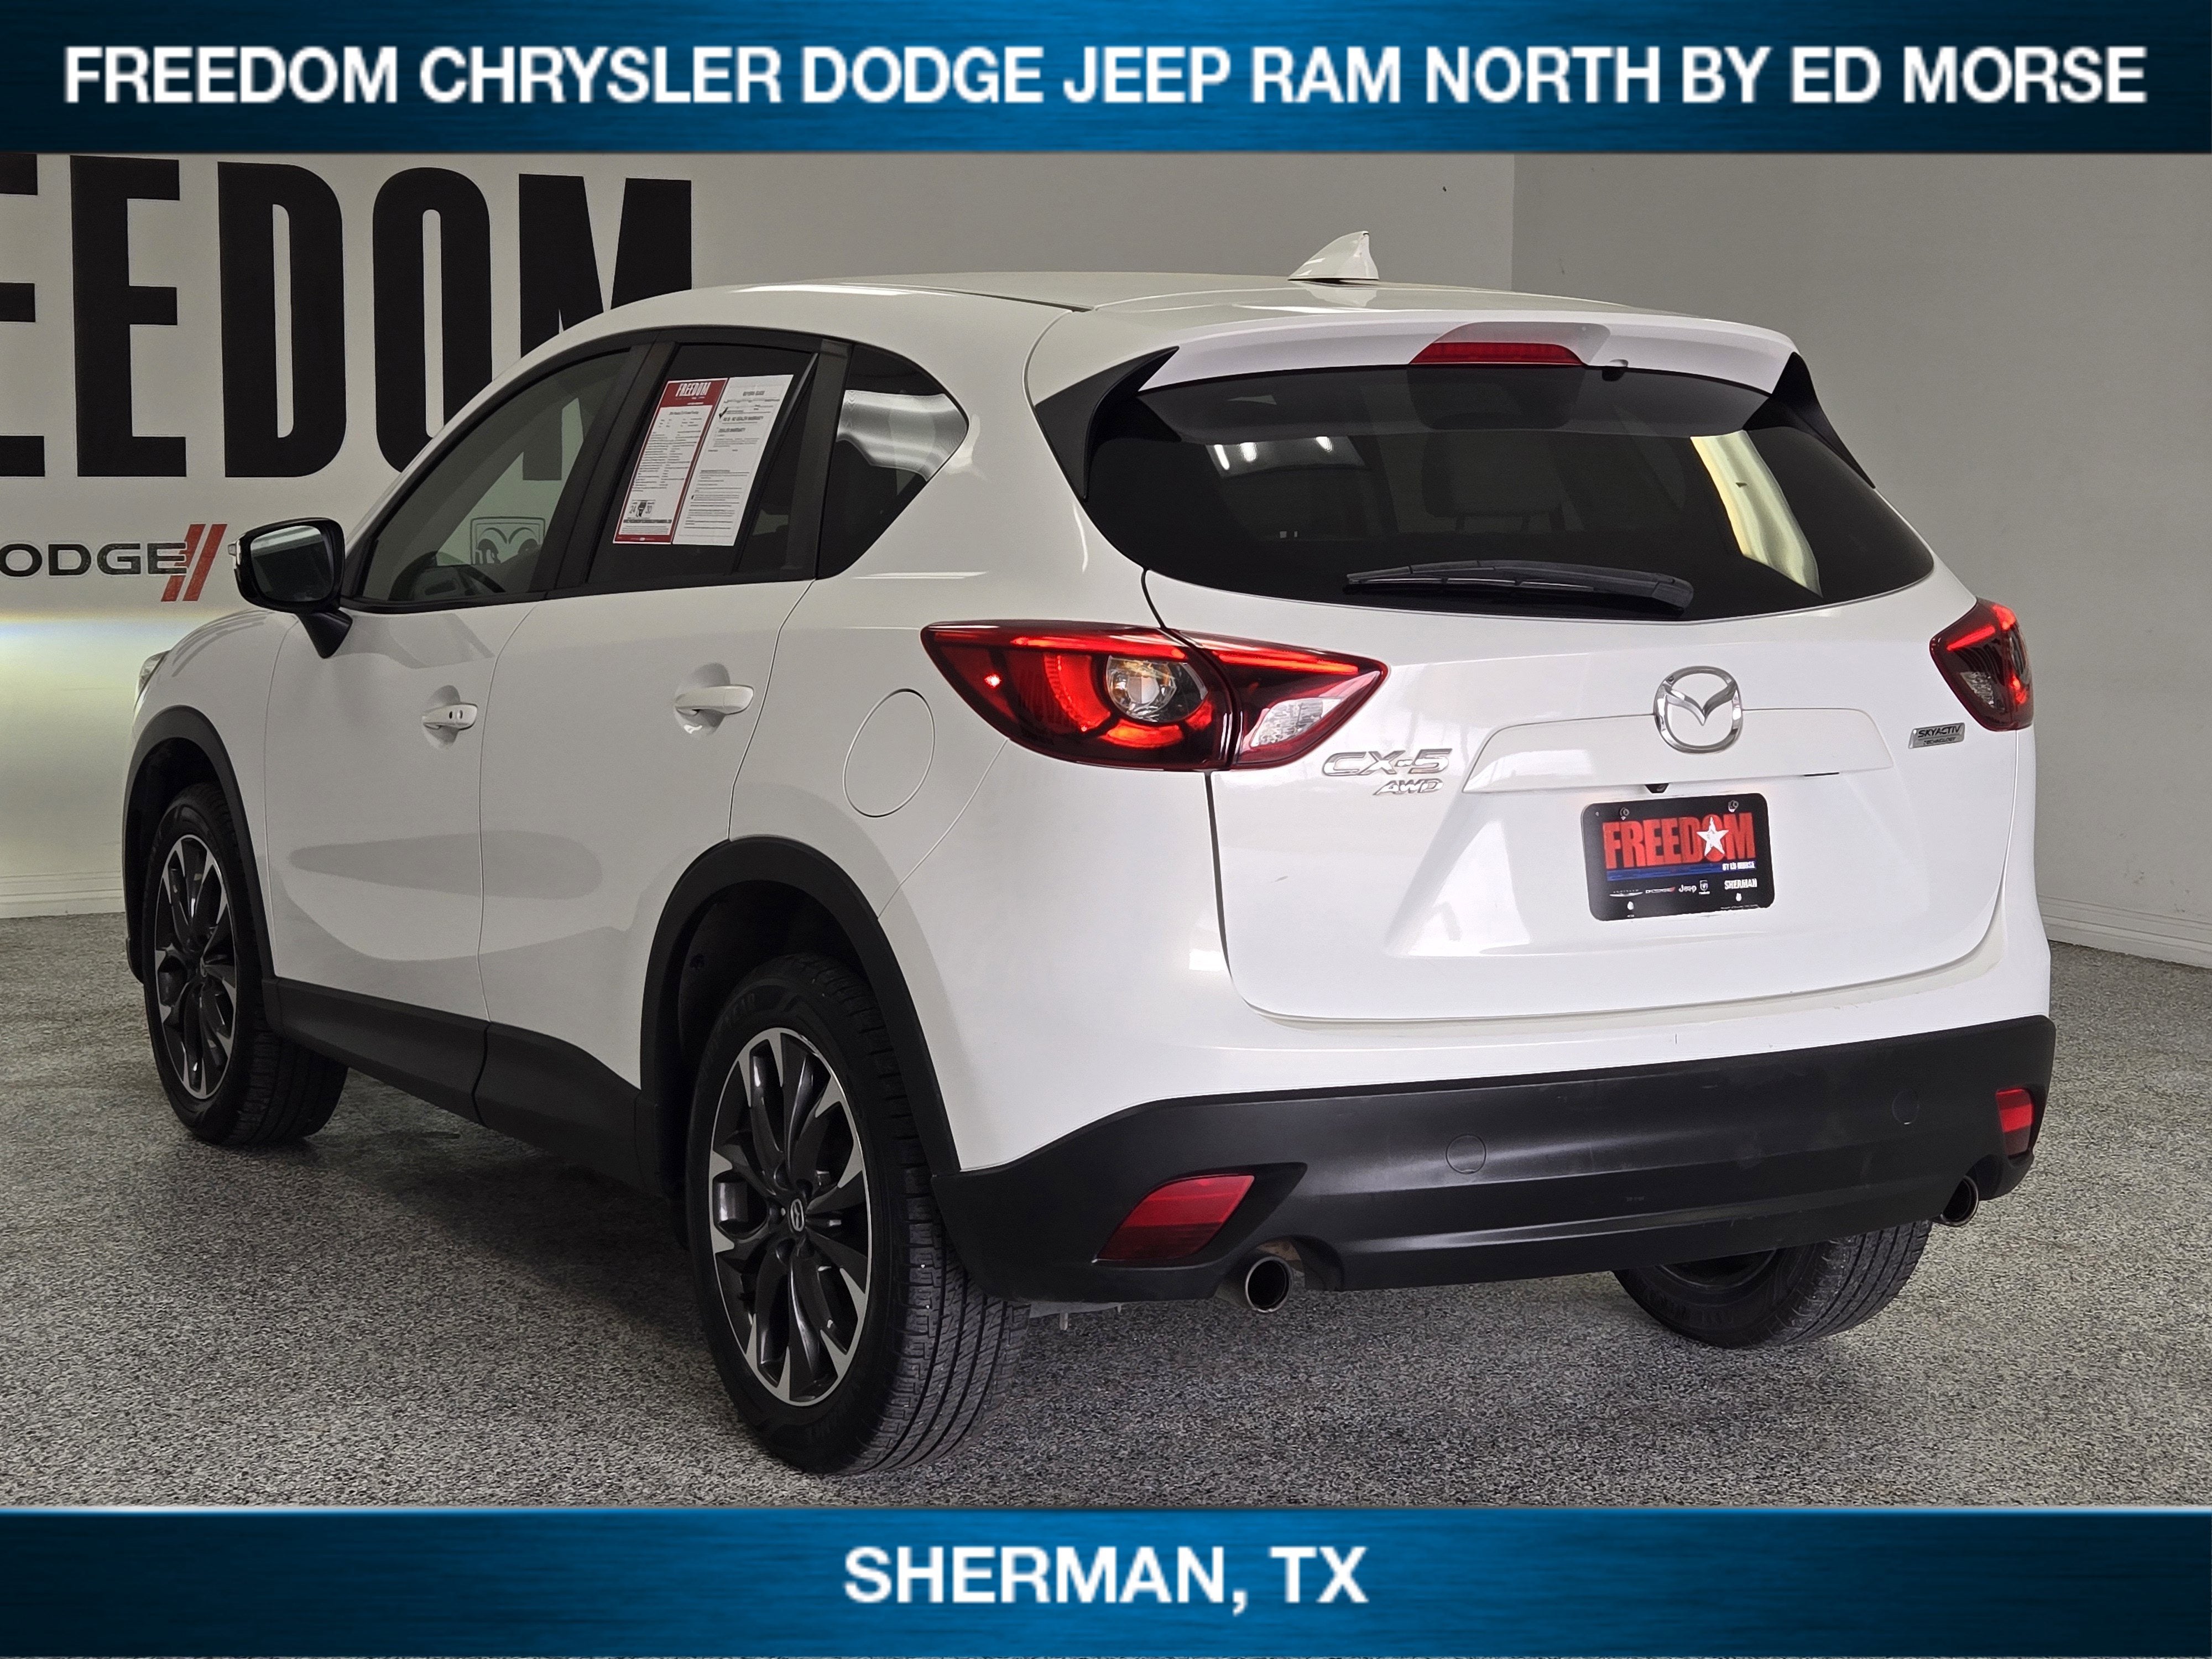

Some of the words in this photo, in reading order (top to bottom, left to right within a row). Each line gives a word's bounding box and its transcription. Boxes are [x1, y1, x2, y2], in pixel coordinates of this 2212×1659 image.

[675, 382, 712, 397] FREEDOM
[1917, 726, 1961, 738] SKYACTIV
[1322, 749, 1452, 776] CX-5
[1373, 778, 1443, 795] AWD
[1603, 812, 1756, 869] FREEDOM
